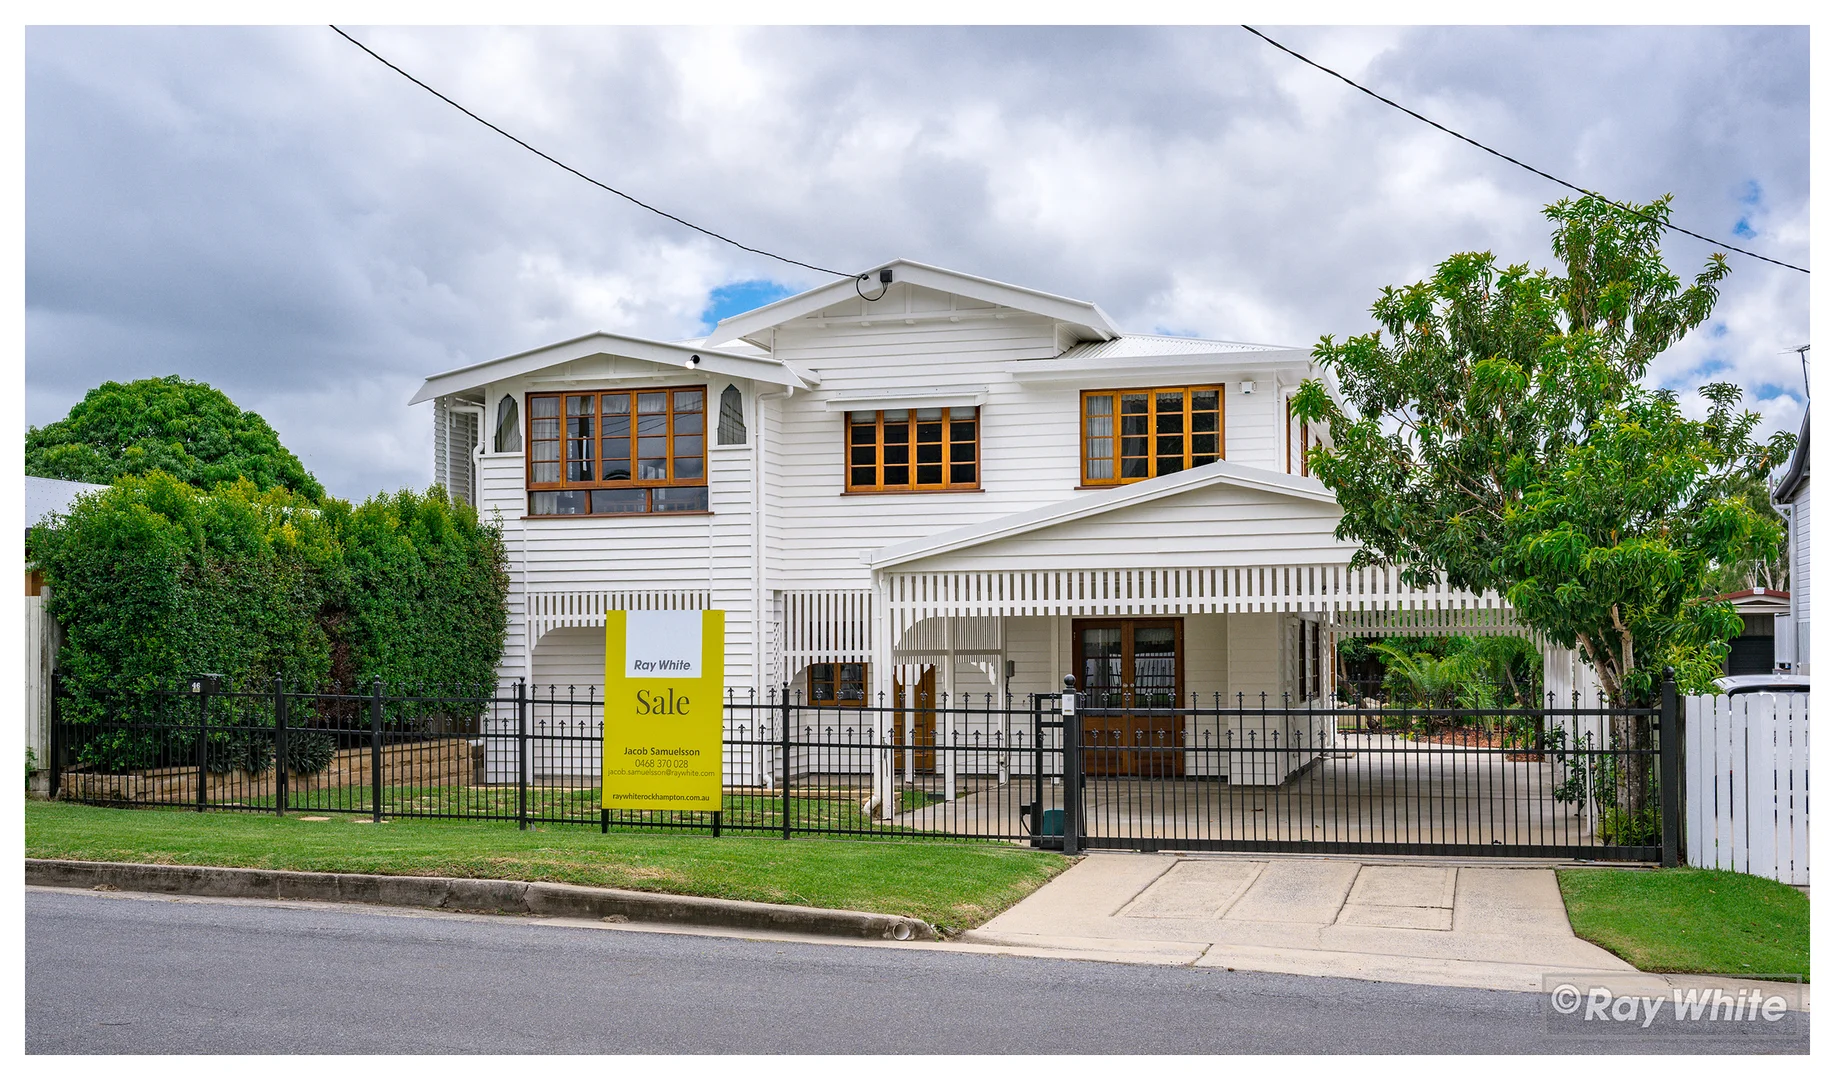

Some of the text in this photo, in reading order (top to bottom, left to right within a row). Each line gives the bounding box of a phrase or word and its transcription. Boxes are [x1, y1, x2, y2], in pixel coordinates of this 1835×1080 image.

[634, 659, 691, 672] Ray White
[636, 687, 690, 716] Sale
[623, 747, 700, 757] Jacob Samuelsson
[635, 759, 689, 769] 0468 370 028
[607, 769, 715, 778] jacob.samuelsson@raywhite.com
[612, 793, 710, 801] raywhiterockhampton.com.au
